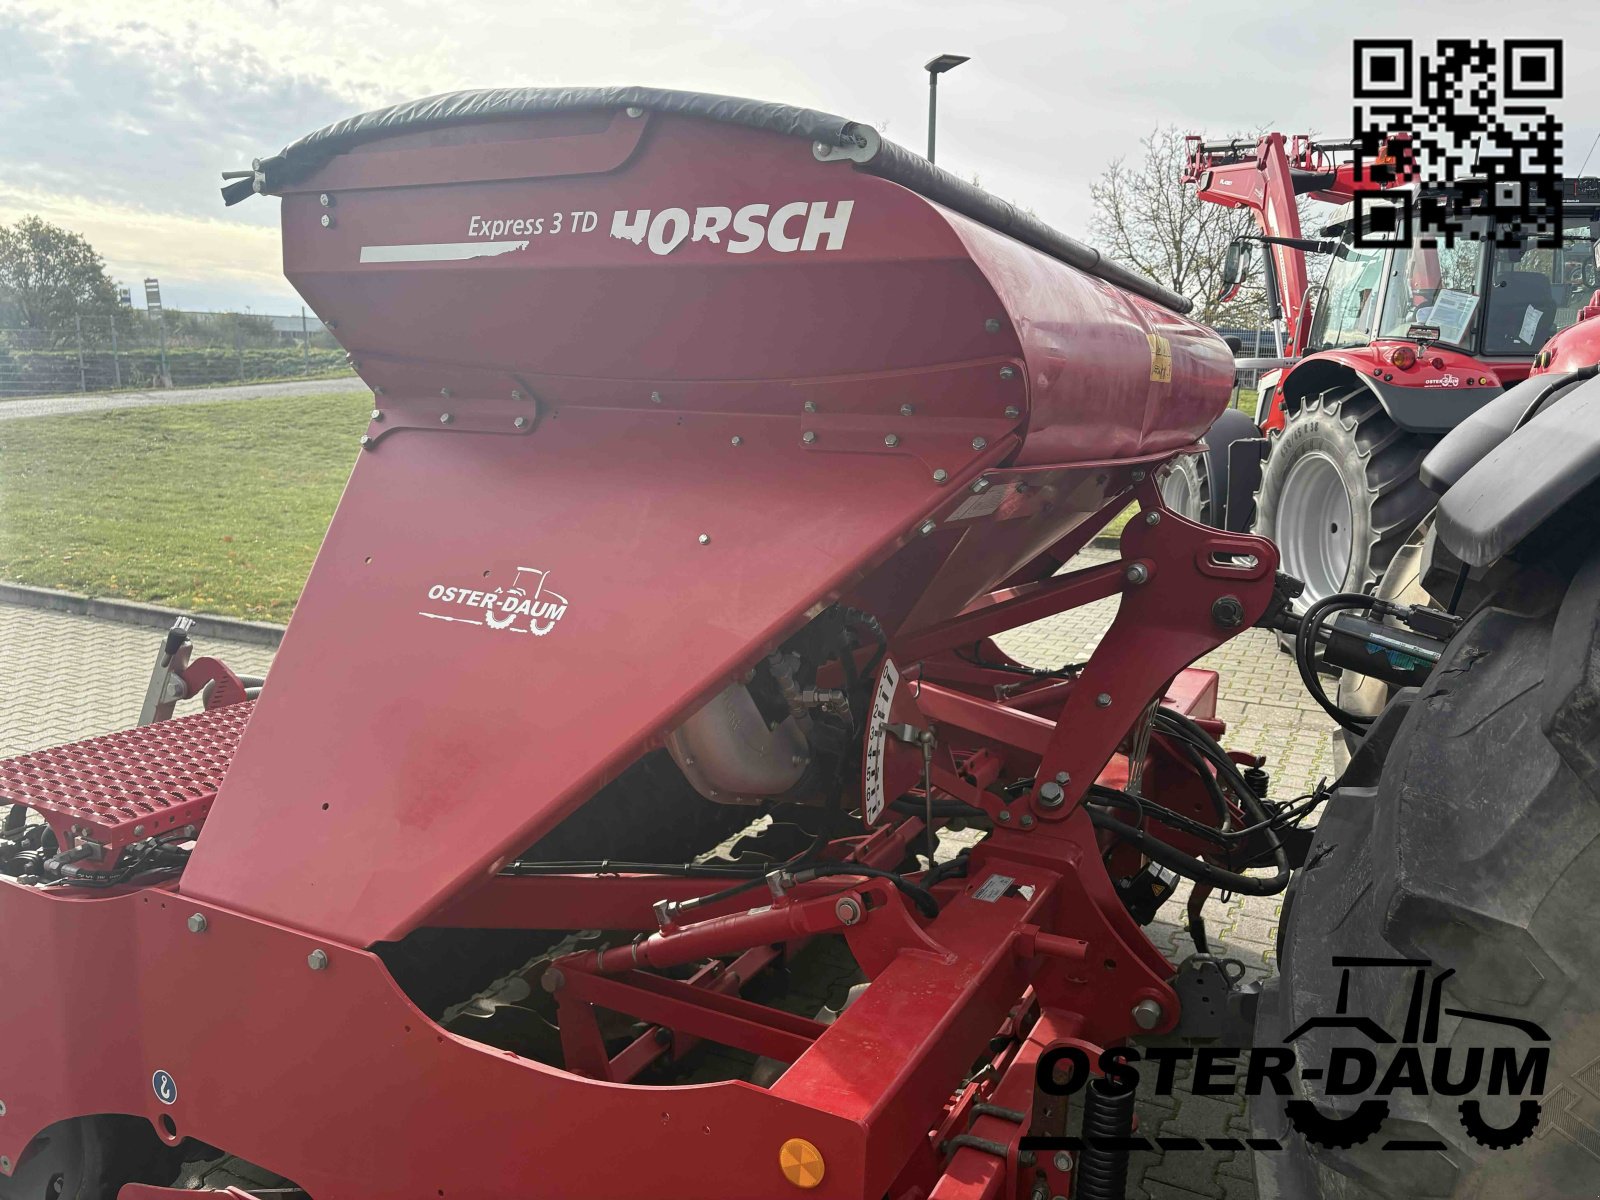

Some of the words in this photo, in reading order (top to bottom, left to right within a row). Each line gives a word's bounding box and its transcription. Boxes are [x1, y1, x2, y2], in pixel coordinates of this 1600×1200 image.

[467, 213, 545, 239] Express
[549, 212, 562, 234] 3
[570, 211, 598, 233] TD
[609, 200, 855, 256] HORSCH
[428, 584, 568, 621] OSTER-DAUM
[882, 665, 889, 679] 0
[872, 704, 879, 719] 2
[869, 726, 875, 741] 3
[867, 748, 873, 760] 4
[866, 767, 871, 781] 5
[866, 787, 871, 801] 6
